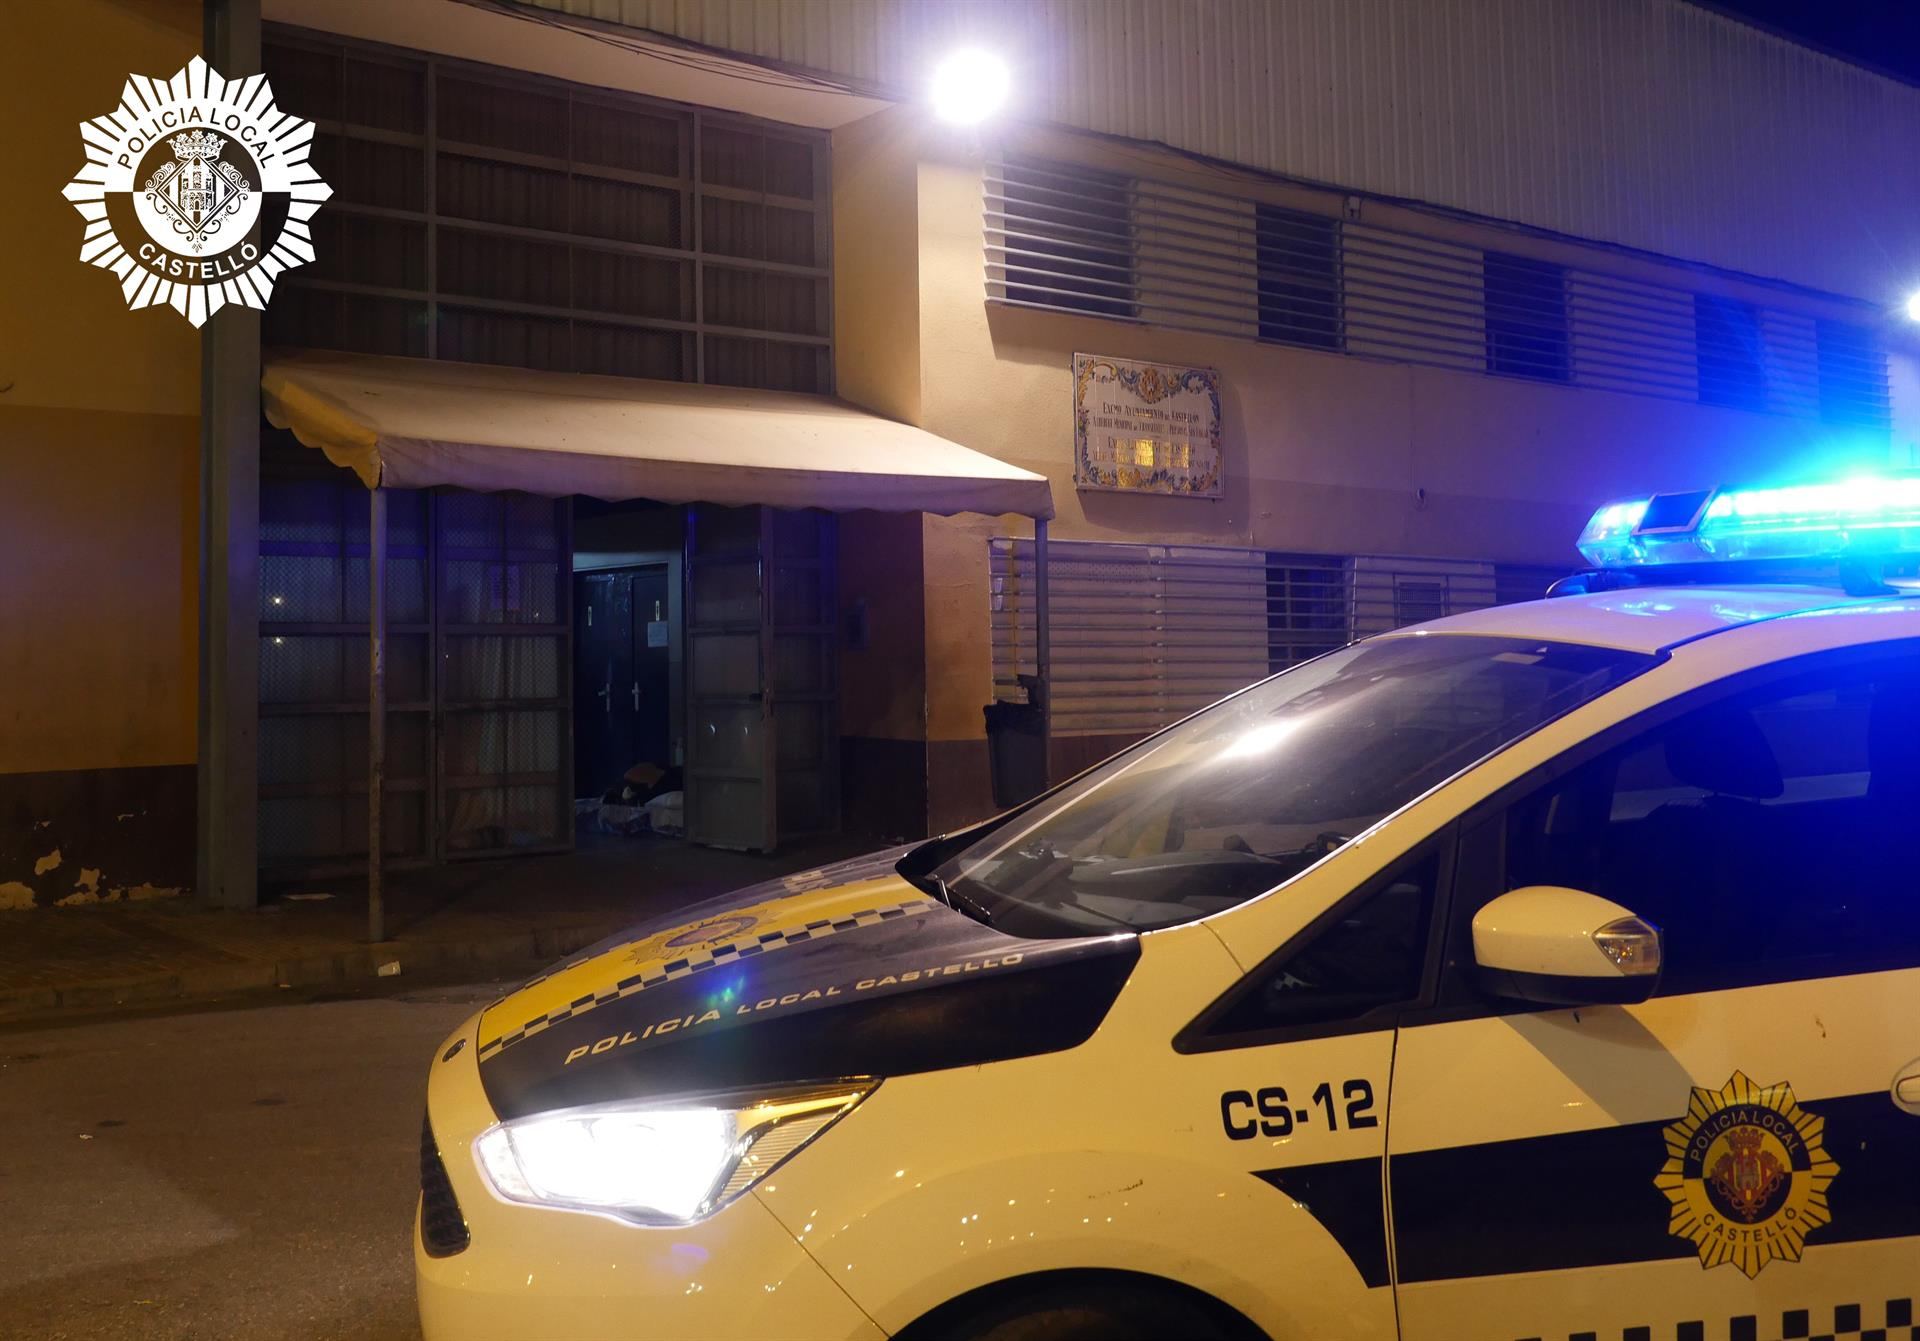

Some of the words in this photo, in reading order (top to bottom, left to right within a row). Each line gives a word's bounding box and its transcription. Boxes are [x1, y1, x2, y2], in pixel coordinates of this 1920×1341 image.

[564, 1008, 721, 1065] POLICIA
[737, 986, 841, 1015] LOCAL
[1220, 1078, 1378, 1141] CS-12
[1690, 1110, 1748, 1162] POLICIA
[1752, 1110, 1800, 1154] LOCAL
